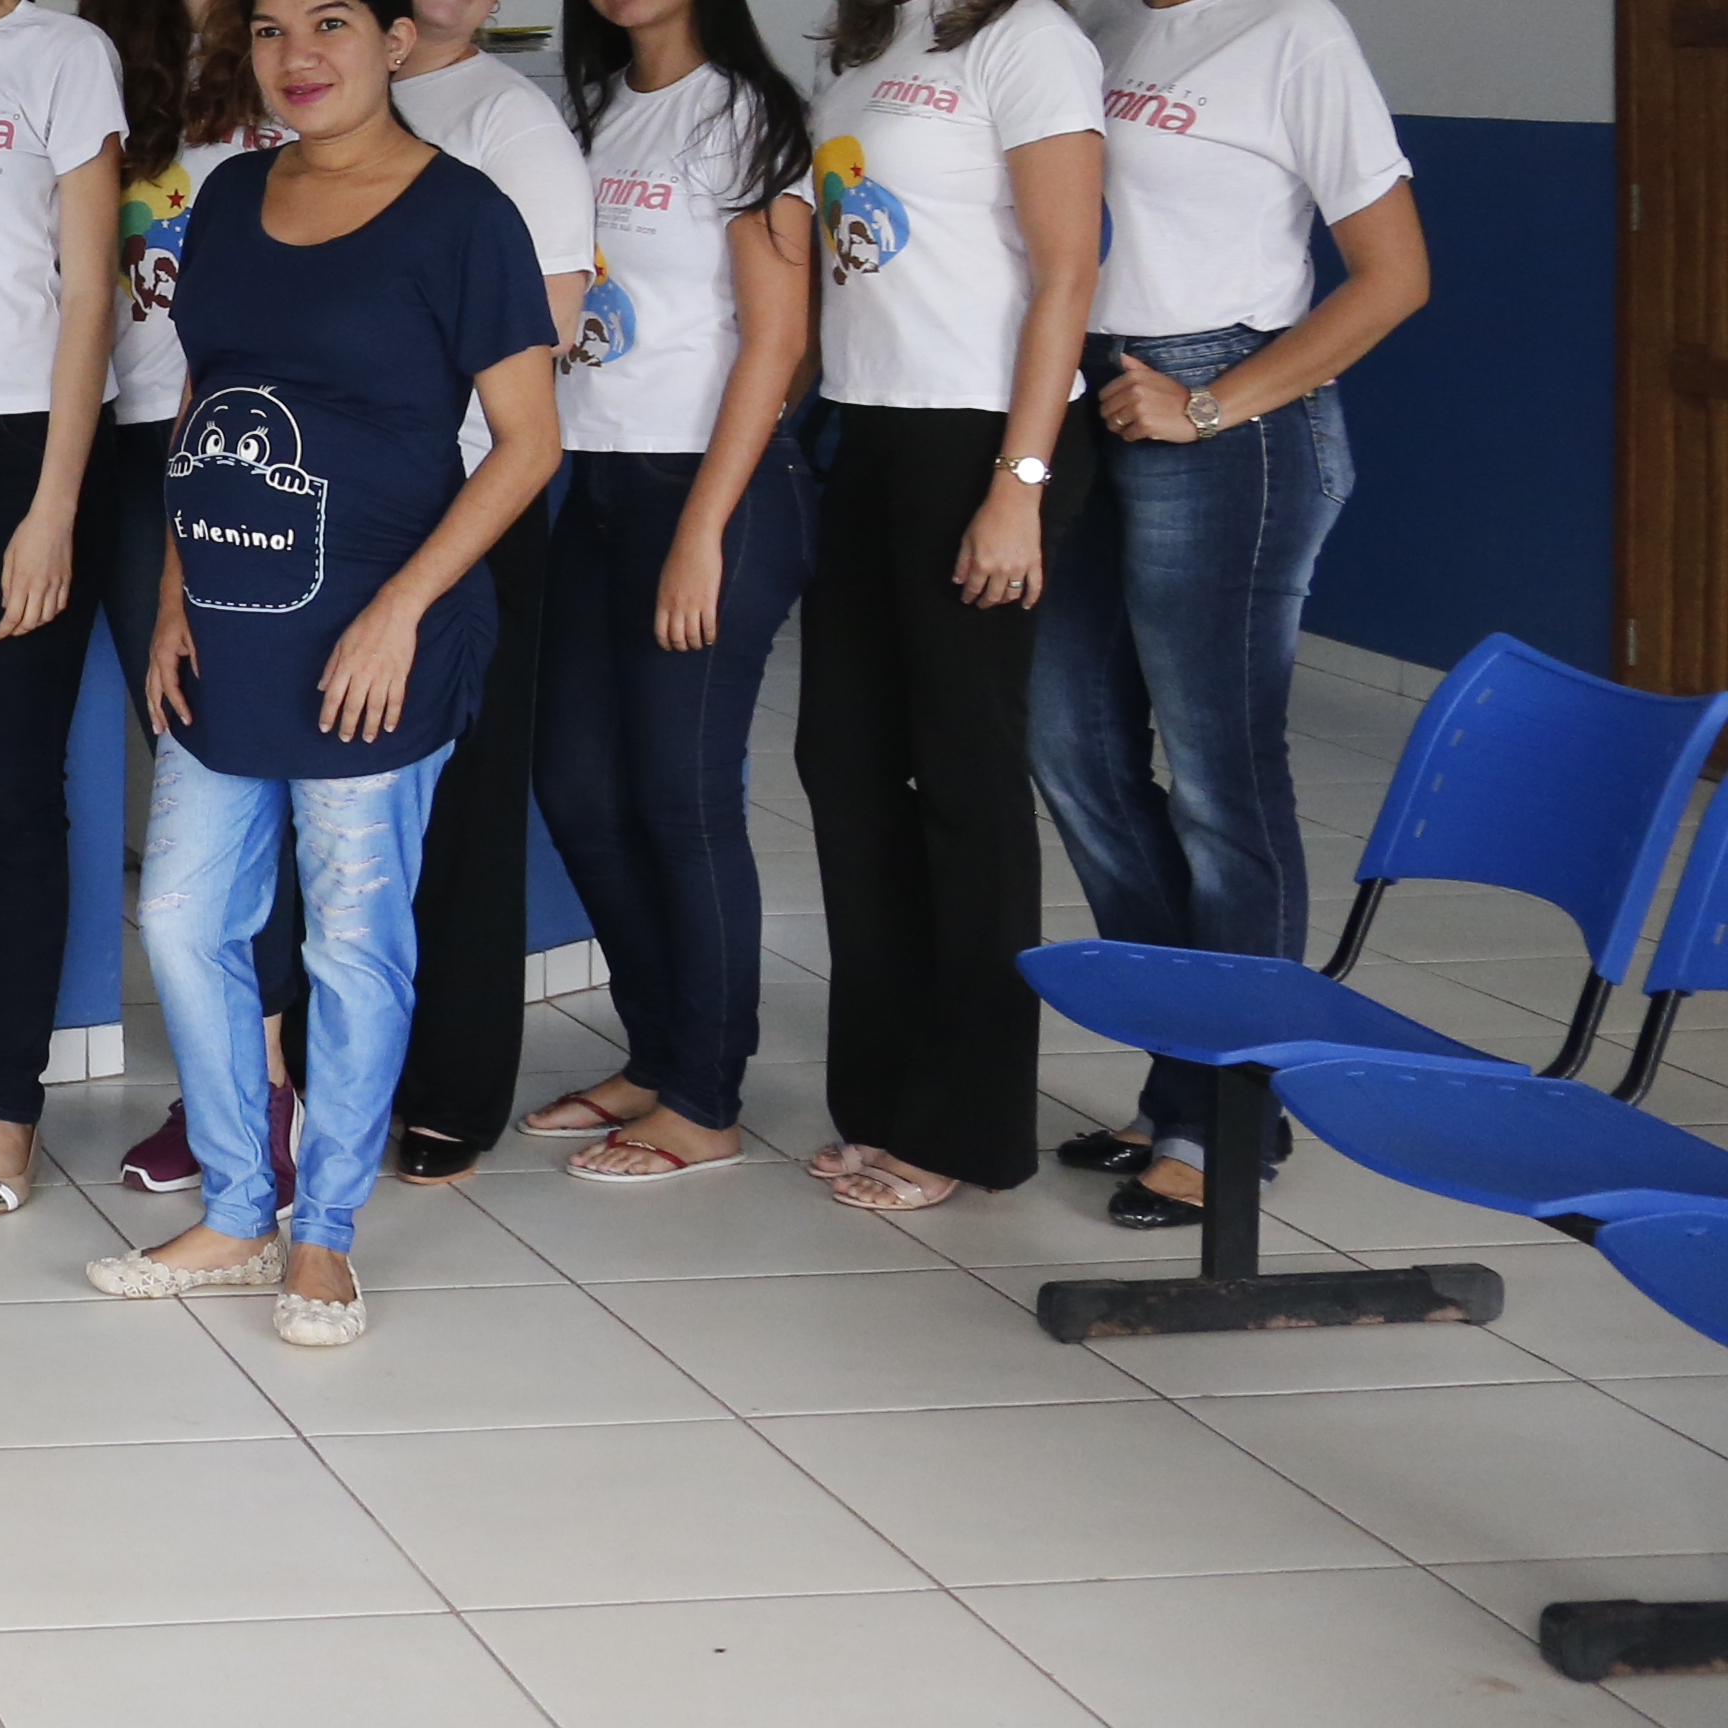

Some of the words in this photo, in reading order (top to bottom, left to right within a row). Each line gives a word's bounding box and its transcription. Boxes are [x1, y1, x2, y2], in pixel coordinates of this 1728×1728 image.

[872, 75, 959, 113] mina
[1104, 84, 1196, 134] mina
[595, 170, 672, 210] mina
[174, 510, 187, 537] É
[192, 519, 294, 550] Menino!
